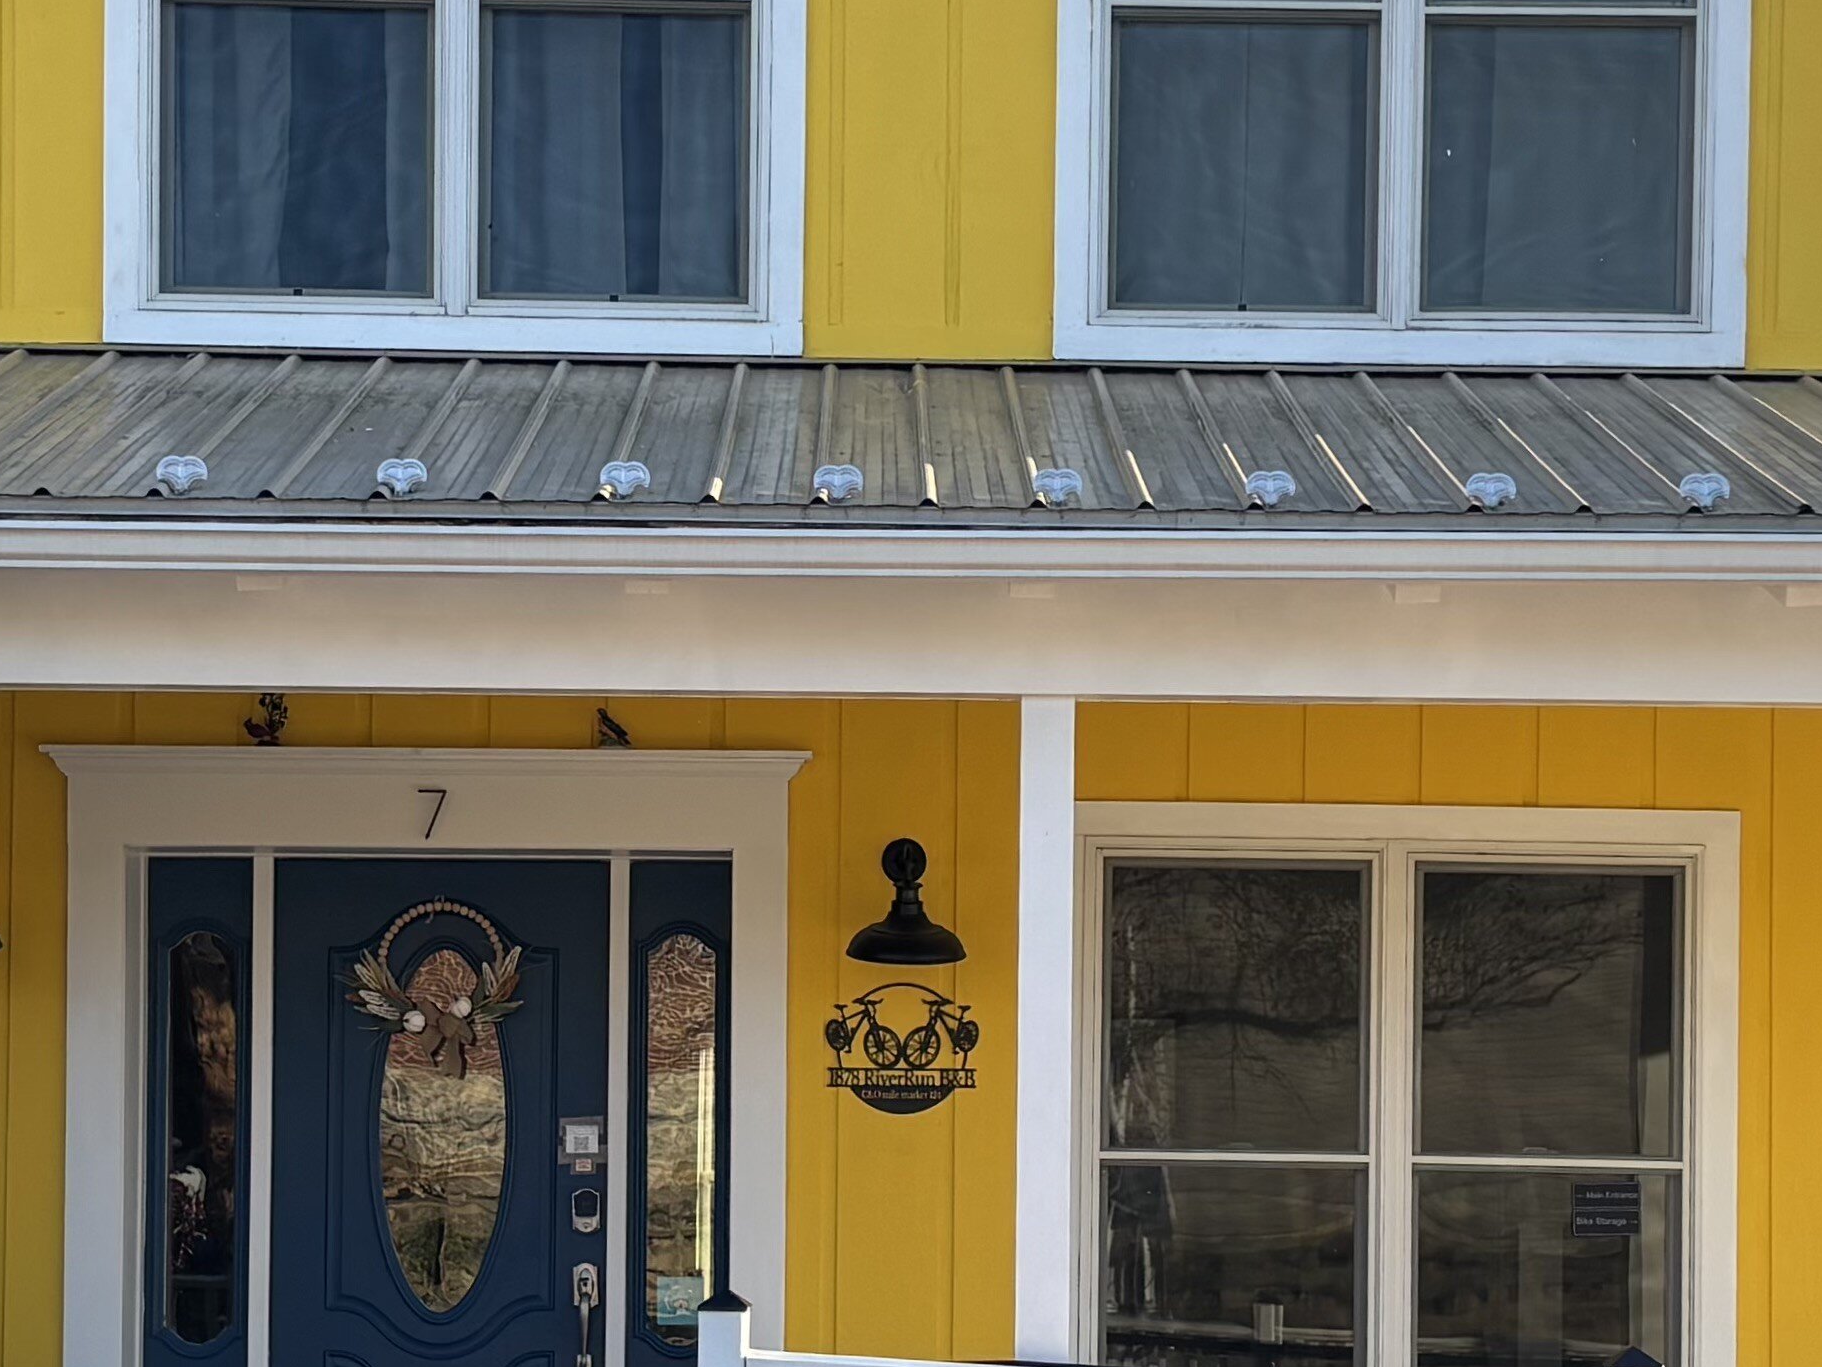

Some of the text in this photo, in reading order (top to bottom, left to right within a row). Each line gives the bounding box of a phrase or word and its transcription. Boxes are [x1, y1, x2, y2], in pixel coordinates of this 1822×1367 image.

[417, 789, 447, 840] 7
[829, 1069, 975, 1087] 1878 RiverRun B&B
